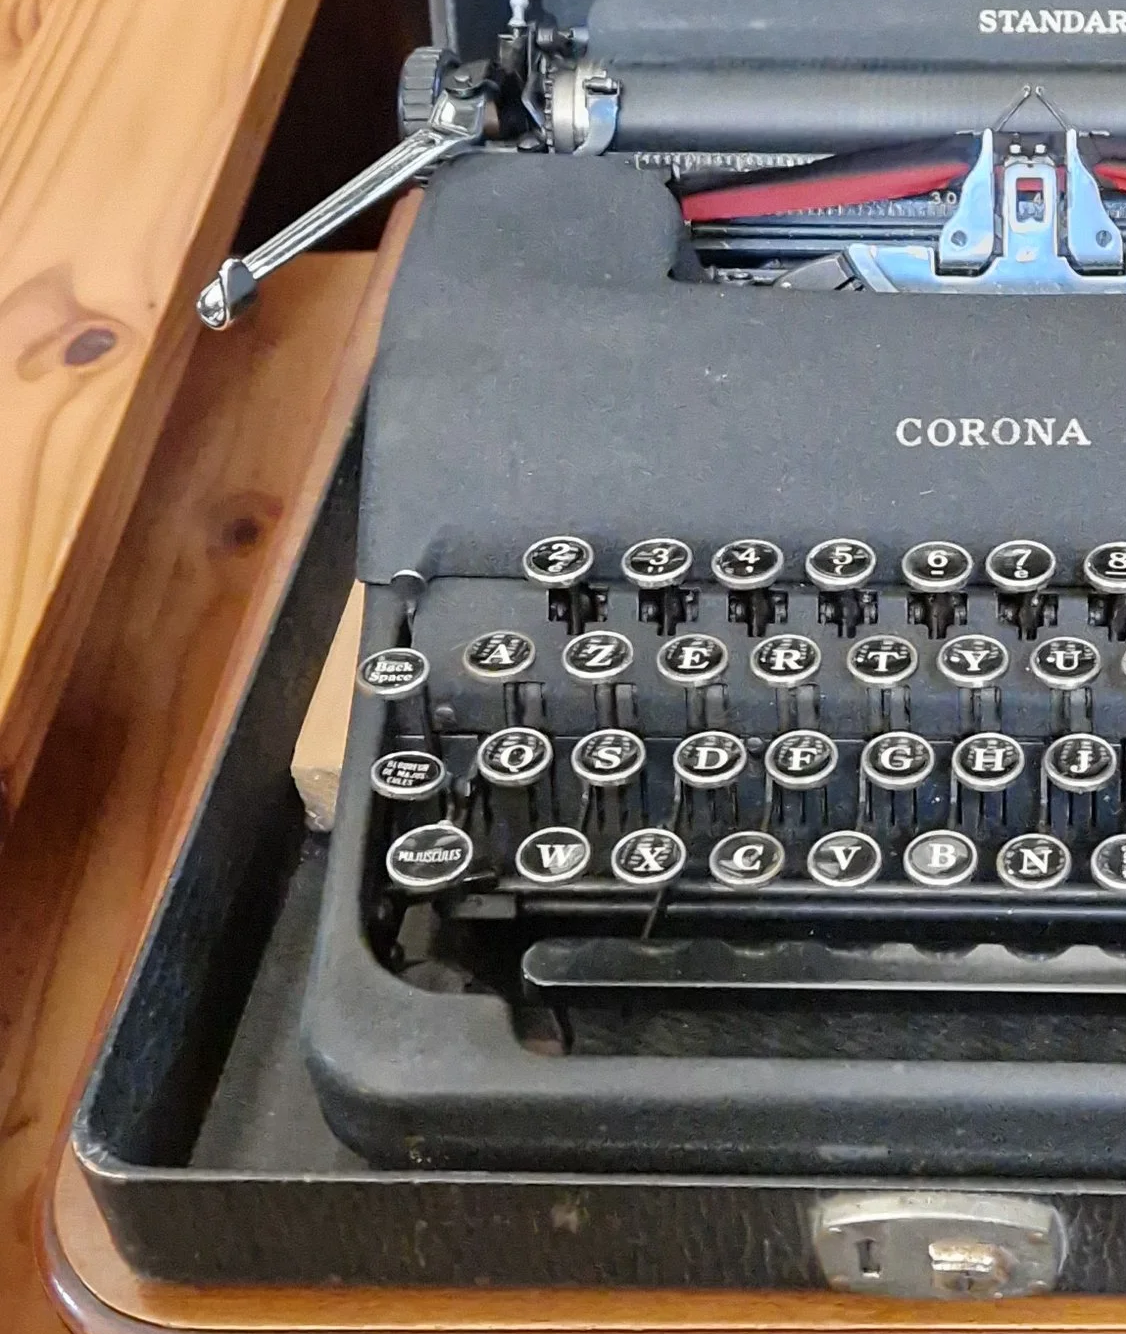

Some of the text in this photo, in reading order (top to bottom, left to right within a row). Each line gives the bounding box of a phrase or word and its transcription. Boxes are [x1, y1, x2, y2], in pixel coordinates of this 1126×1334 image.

[895, 417, 1092, 447] CORONA
[549, 542, 571, 561] 2
[649, 547, 670, 565] 3
[738, 547, 761, 564] 4
[832, 546, 853, 565] 5
[927, 550, 948, 567] 6
[1011, 549, 1032, 567] 7
[375, 661, 413, 672] Back
[480, 643, 514, 665] A
[585, 643, 616, 666] Z
[678, 646, 710, 670] E
[771, 649, 803, 670] R
[868, 651, 899, 672] T
[957, 650, 990, 671] Y
[1052, 650, 1082, 671] U
[368, 671, 413, 683] Space
[500, 744, 534, 772] Q
[595, 747, 622, 769] S
[693, 746, 729, 769] D
[787, 747, 818, 771] F
[880, 746, 914, 771] G
[971, 747, 1006, 772] H
[1070, 750, 1093, 773] J
[398, 848, 462, 863] MAJUSCULES
[535, 843, 583, 869] W
[633, 846, 667, 872] X
[732, 845, 764, 871] C
[828, 845, 862, 871] V
[927, 843, 958, 868] B
[1018, 848, 1053, 874] N
